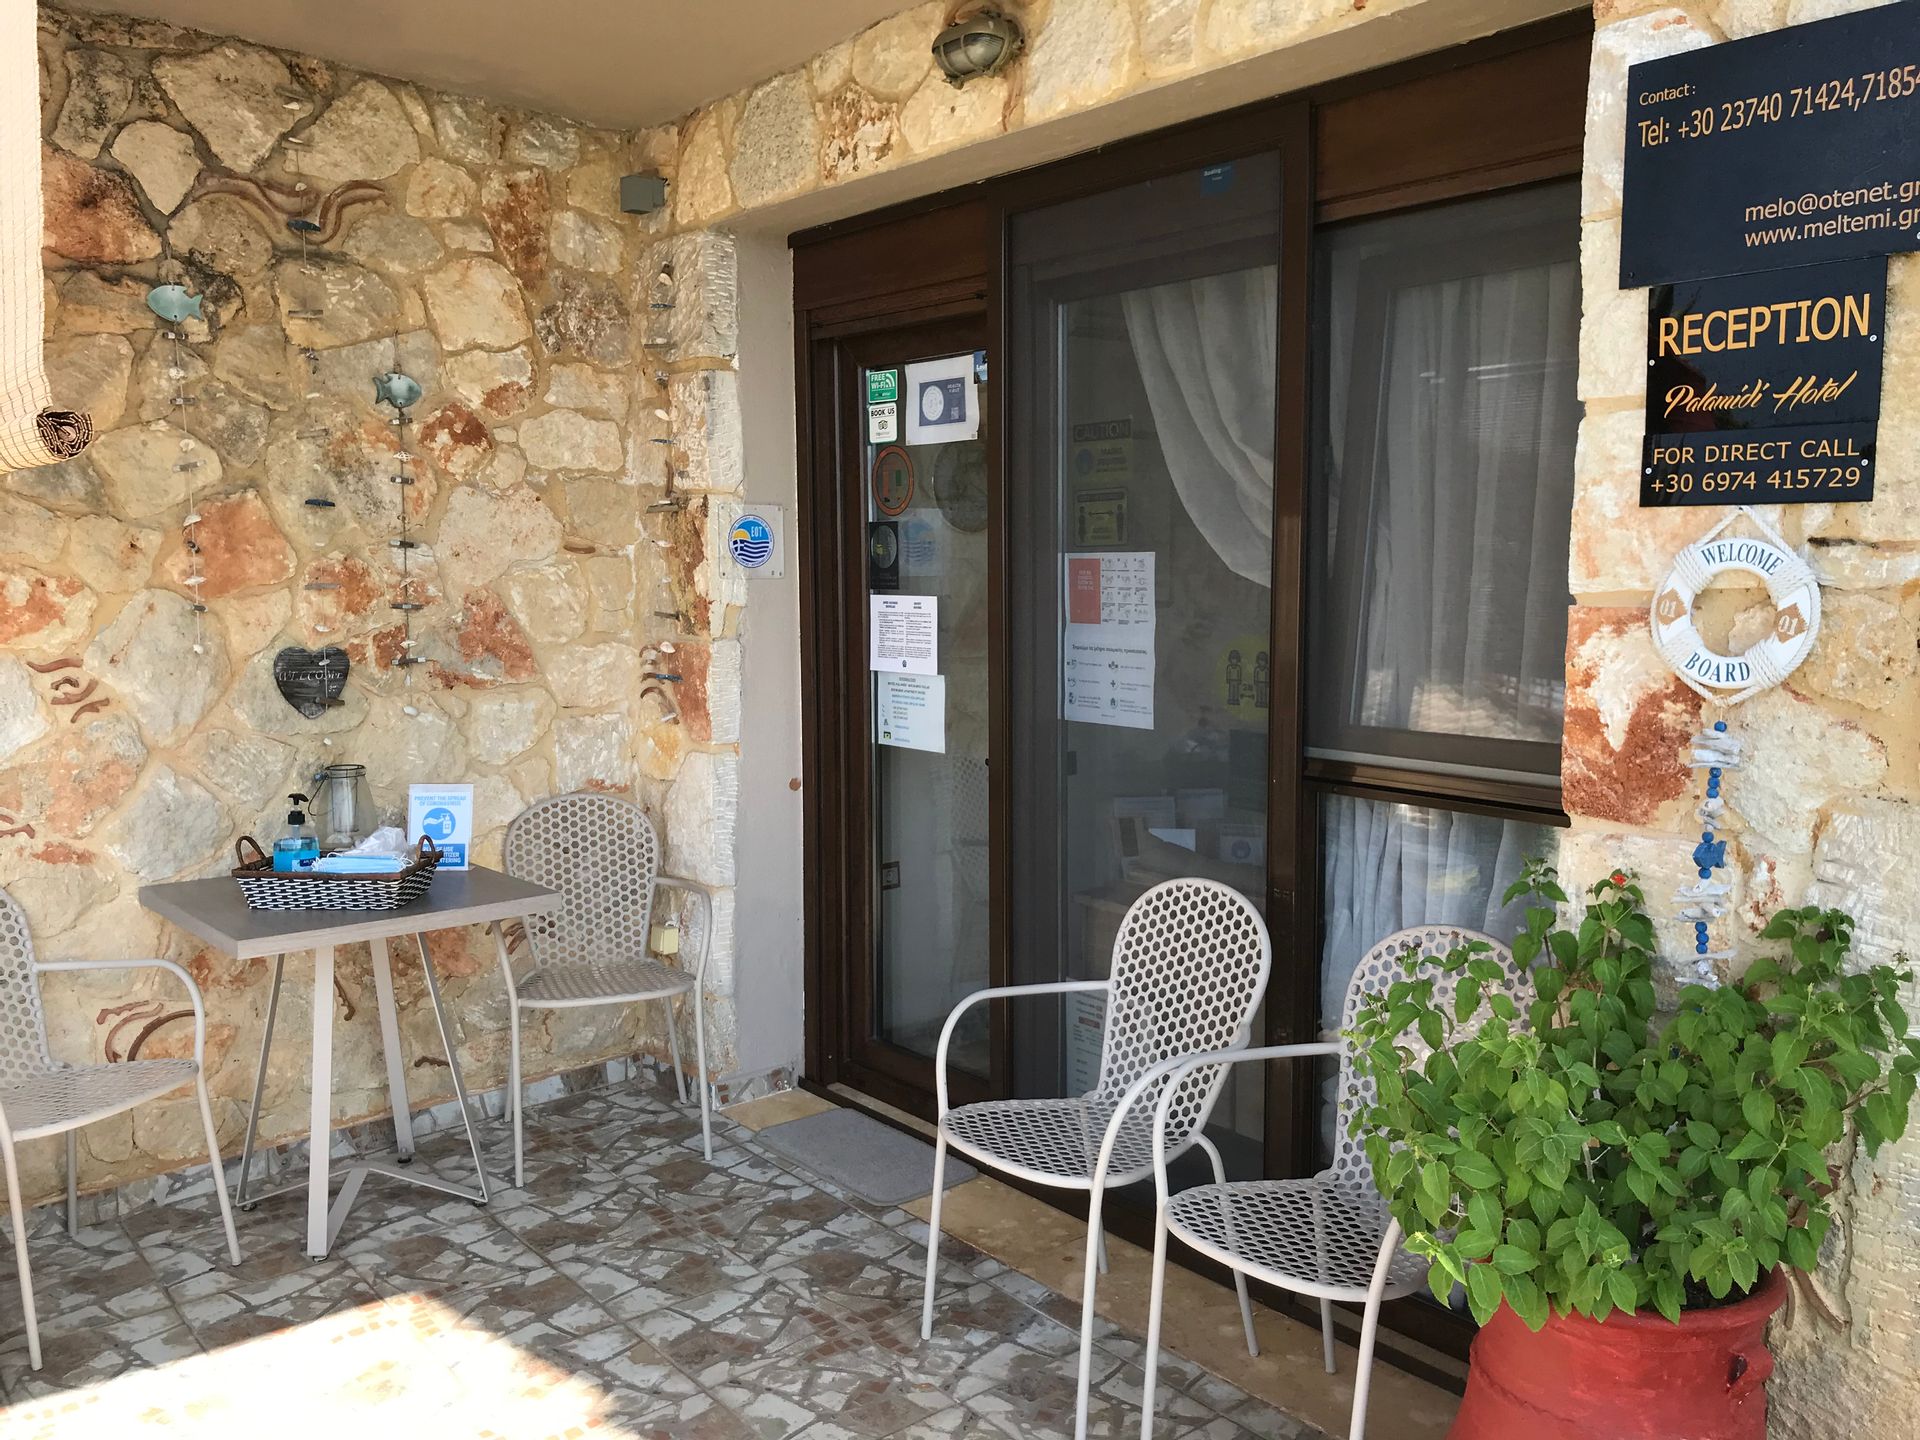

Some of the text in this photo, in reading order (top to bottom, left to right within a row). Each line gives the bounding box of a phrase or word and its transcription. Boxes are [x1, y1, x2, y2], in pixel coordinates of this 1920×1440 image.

[1638, 117, 1670, 148] Tel:
[1678, 107, 1714, 139] +30
[1720, 93, 1783, 132] 23740
[1745, 179, 1920, 222] melo@otenet.gr
[1745, 206, 1920, 247] www.meltemi.gr
[1658, 293, 1871, 357] RECEPTION
[871, 374, 886, 382] FREE
[1664, 370, 1858, 419] Palamidi Hotel
[1075, 421, 1131, 440] CAUTION
[1653, 438, 1860, 465] FOR DIRECT CALL
[1651, 466, 1860, 493] +30 6974 415729
[1701, 543, 1784, 576] WELCOME
[1660, 598, 1676, 617] 01
[1779, 615, 1799, 636] 01
[278, 669, 344, 682] WELCOME
[1685, 652, 1750, 682] BOARD
